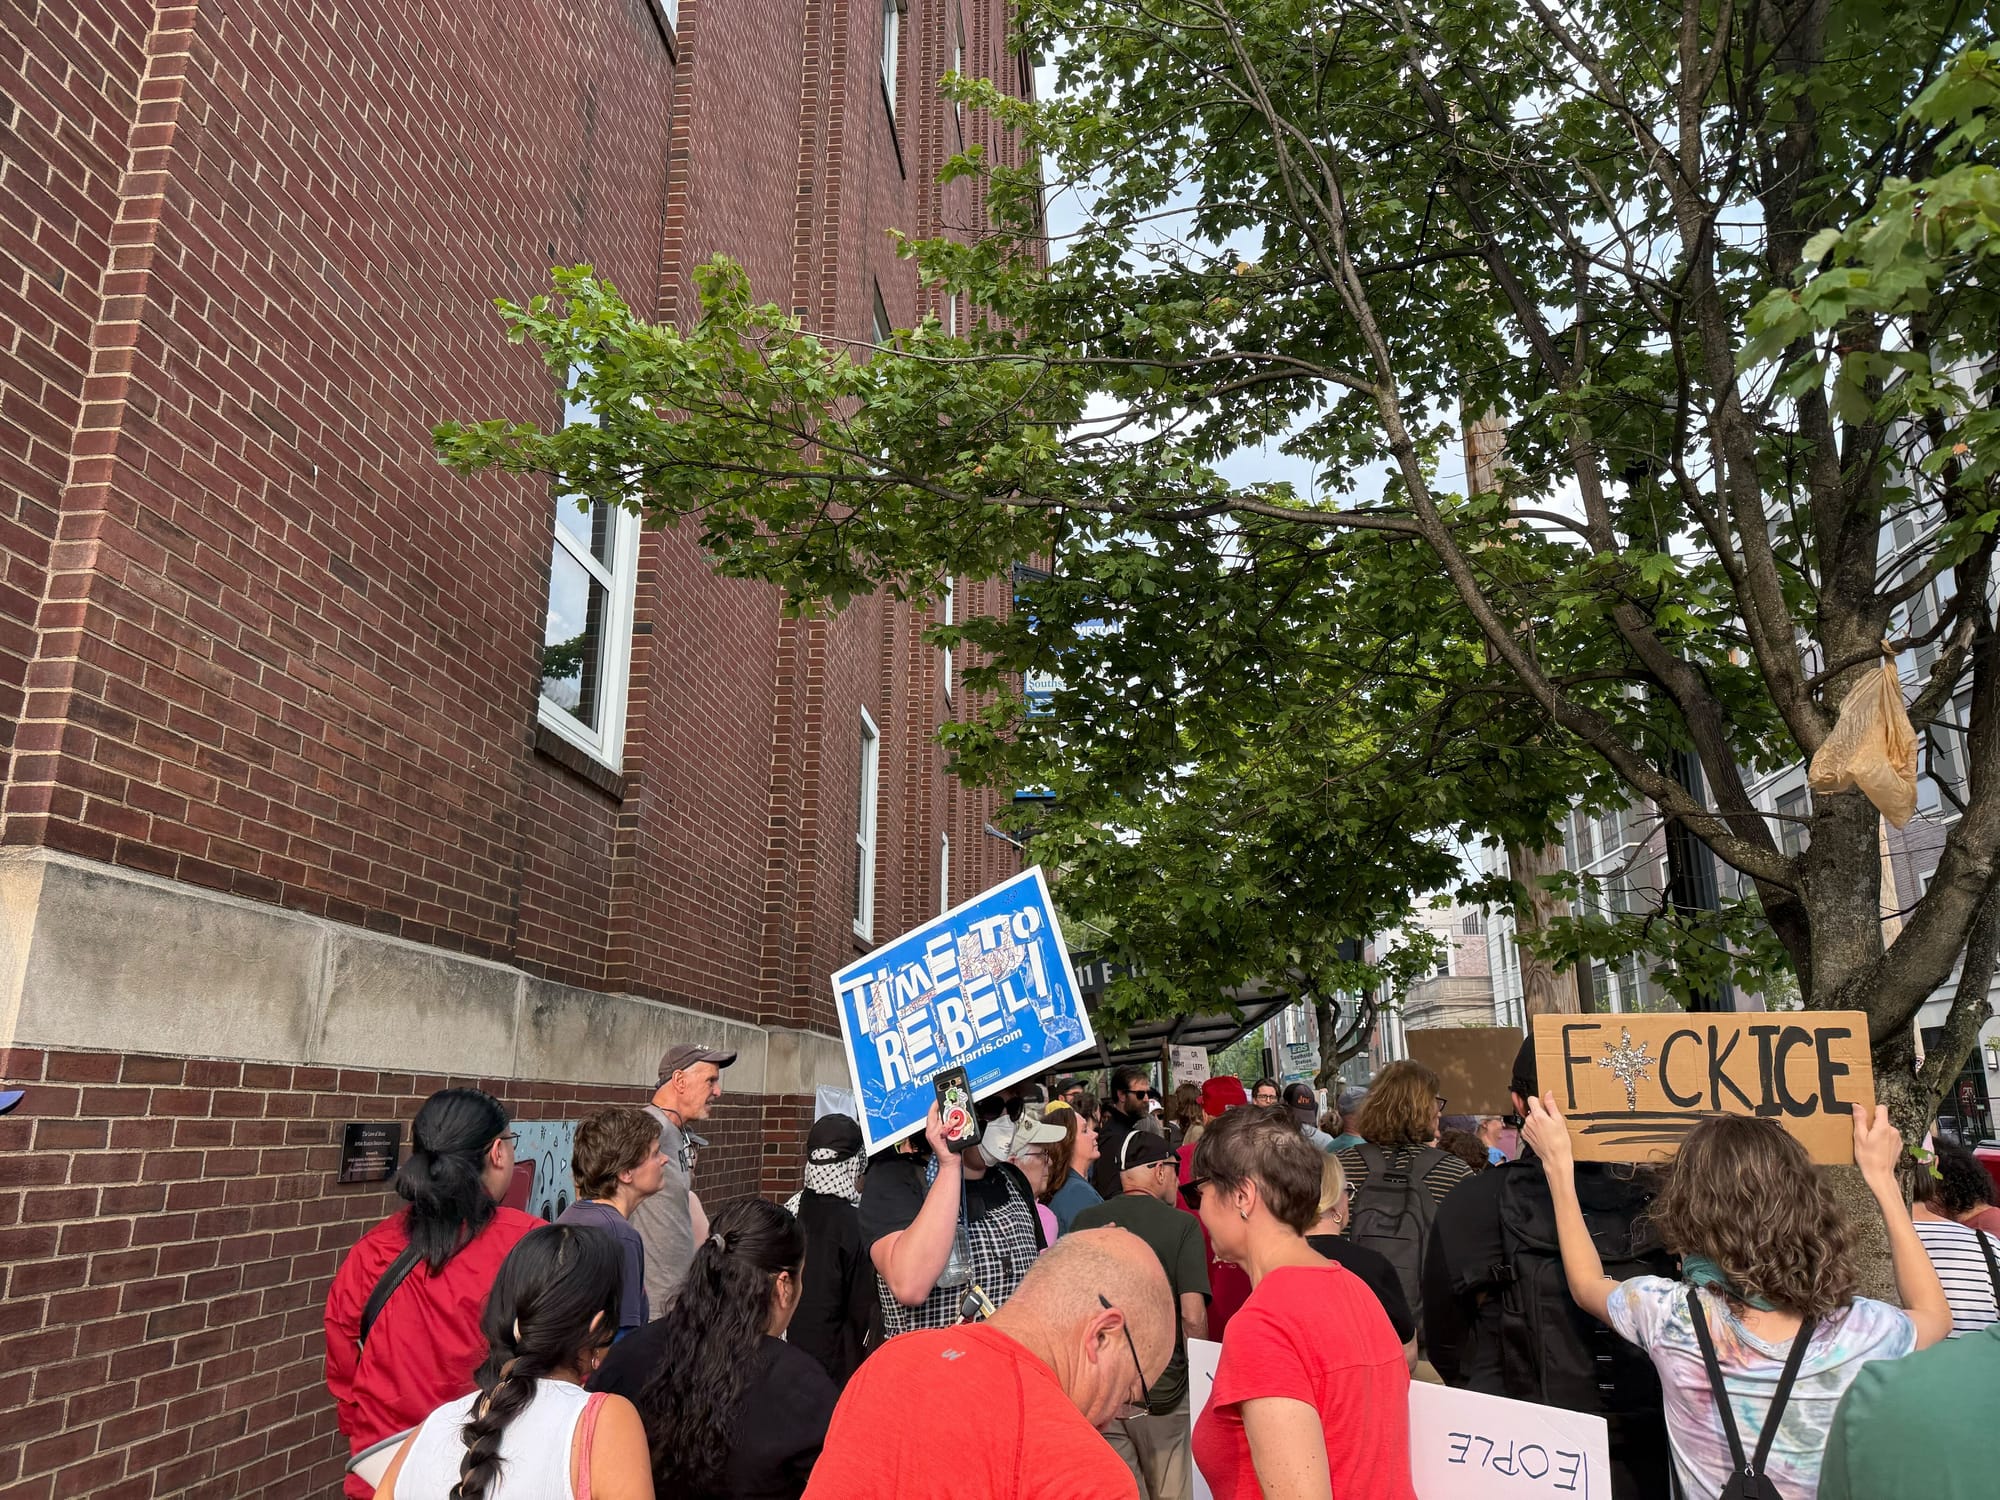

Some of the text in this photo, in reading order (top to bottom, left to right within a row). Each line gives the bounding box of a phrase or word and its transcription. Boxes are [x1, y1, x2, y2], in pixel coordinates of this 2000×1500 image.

[839, 906, 1041, 1035] TIME TO
[875, 940, 1056, 1093] REBEL!
[912, 1028, 1023, 1087] KamalaHarris.com
